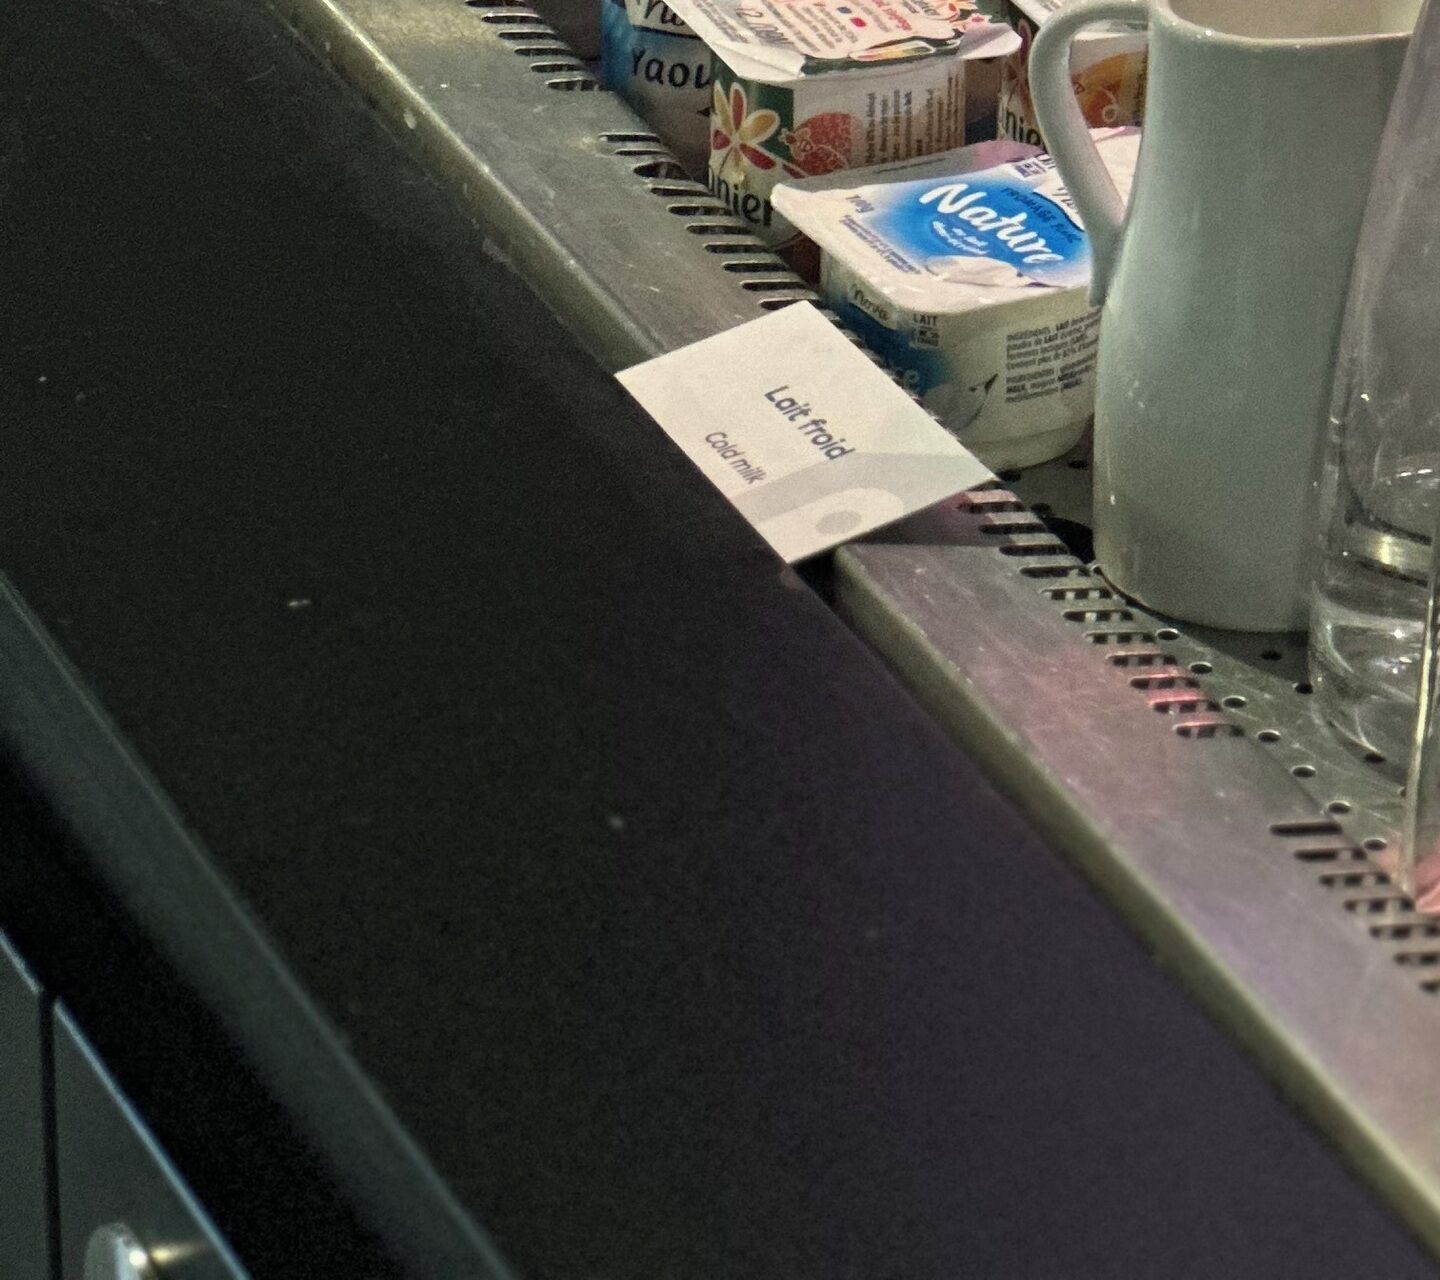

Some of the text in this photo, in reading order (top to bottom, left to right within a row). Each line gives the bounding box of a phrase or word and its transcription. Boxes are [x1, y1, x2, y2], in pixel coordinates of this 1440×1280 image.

[918, 182, 1064, 265] Nature
[704, 430, 769, 486] Cold milk
[763, 385, 857, 462] Lait froid
